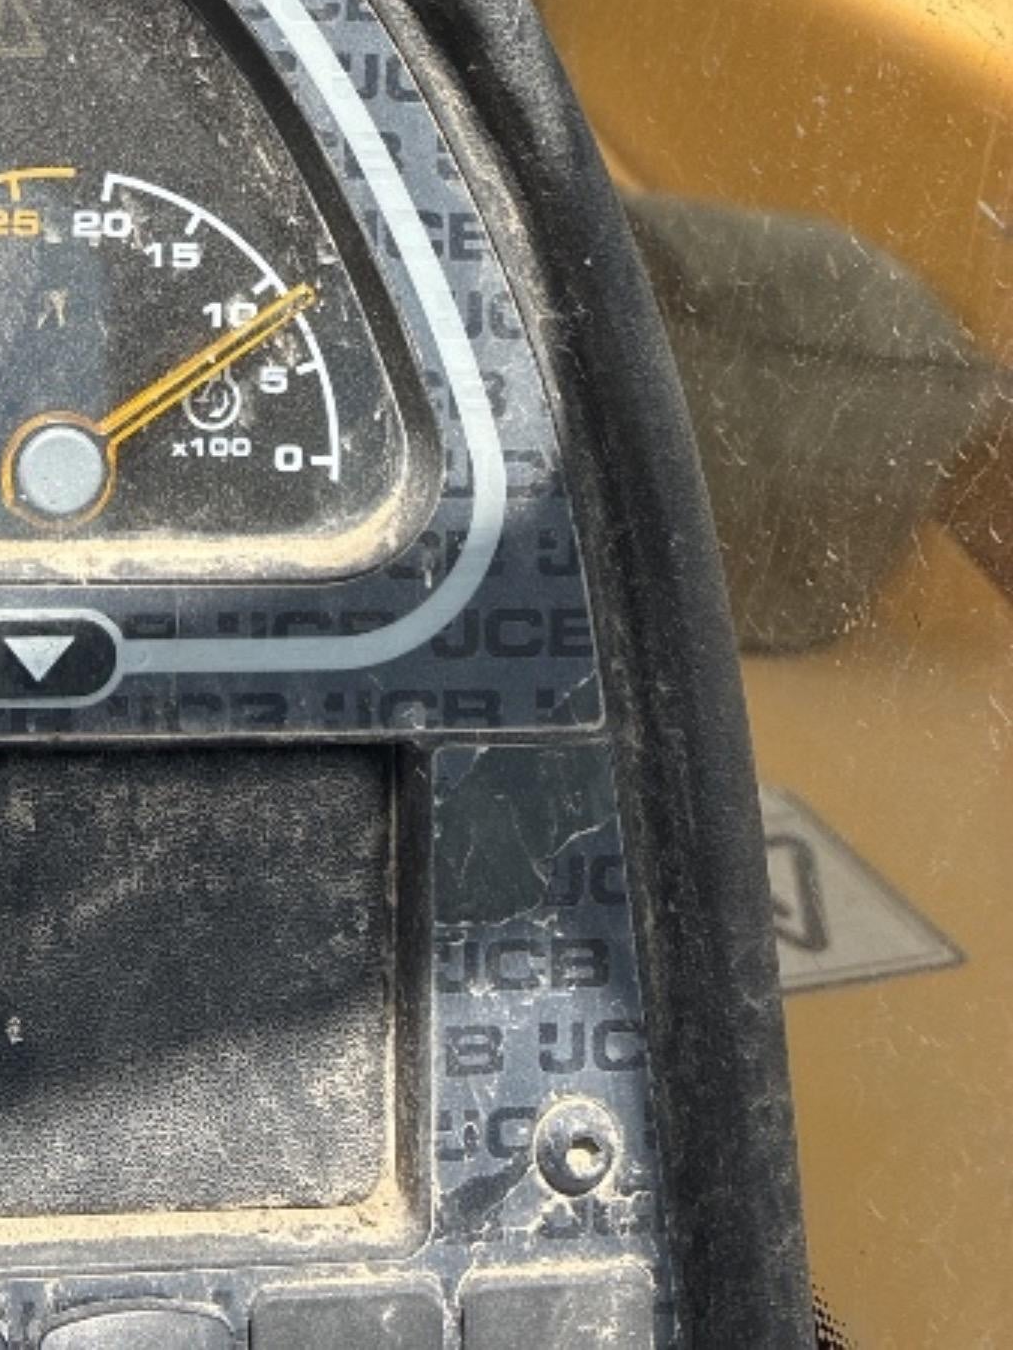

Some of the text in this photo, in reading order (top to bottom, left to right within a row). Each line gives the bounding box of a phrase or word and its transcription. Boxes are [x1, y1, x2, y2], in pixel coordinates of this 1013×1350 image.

[72, 211, 132, 238] 20
[143, 242, 201, 269] 15
[202, 302, 258, 328] 10
[259, 367, 288, 393] 5
[172, 437, 252, 458] x100
[274, 446, 303, 471] 0
